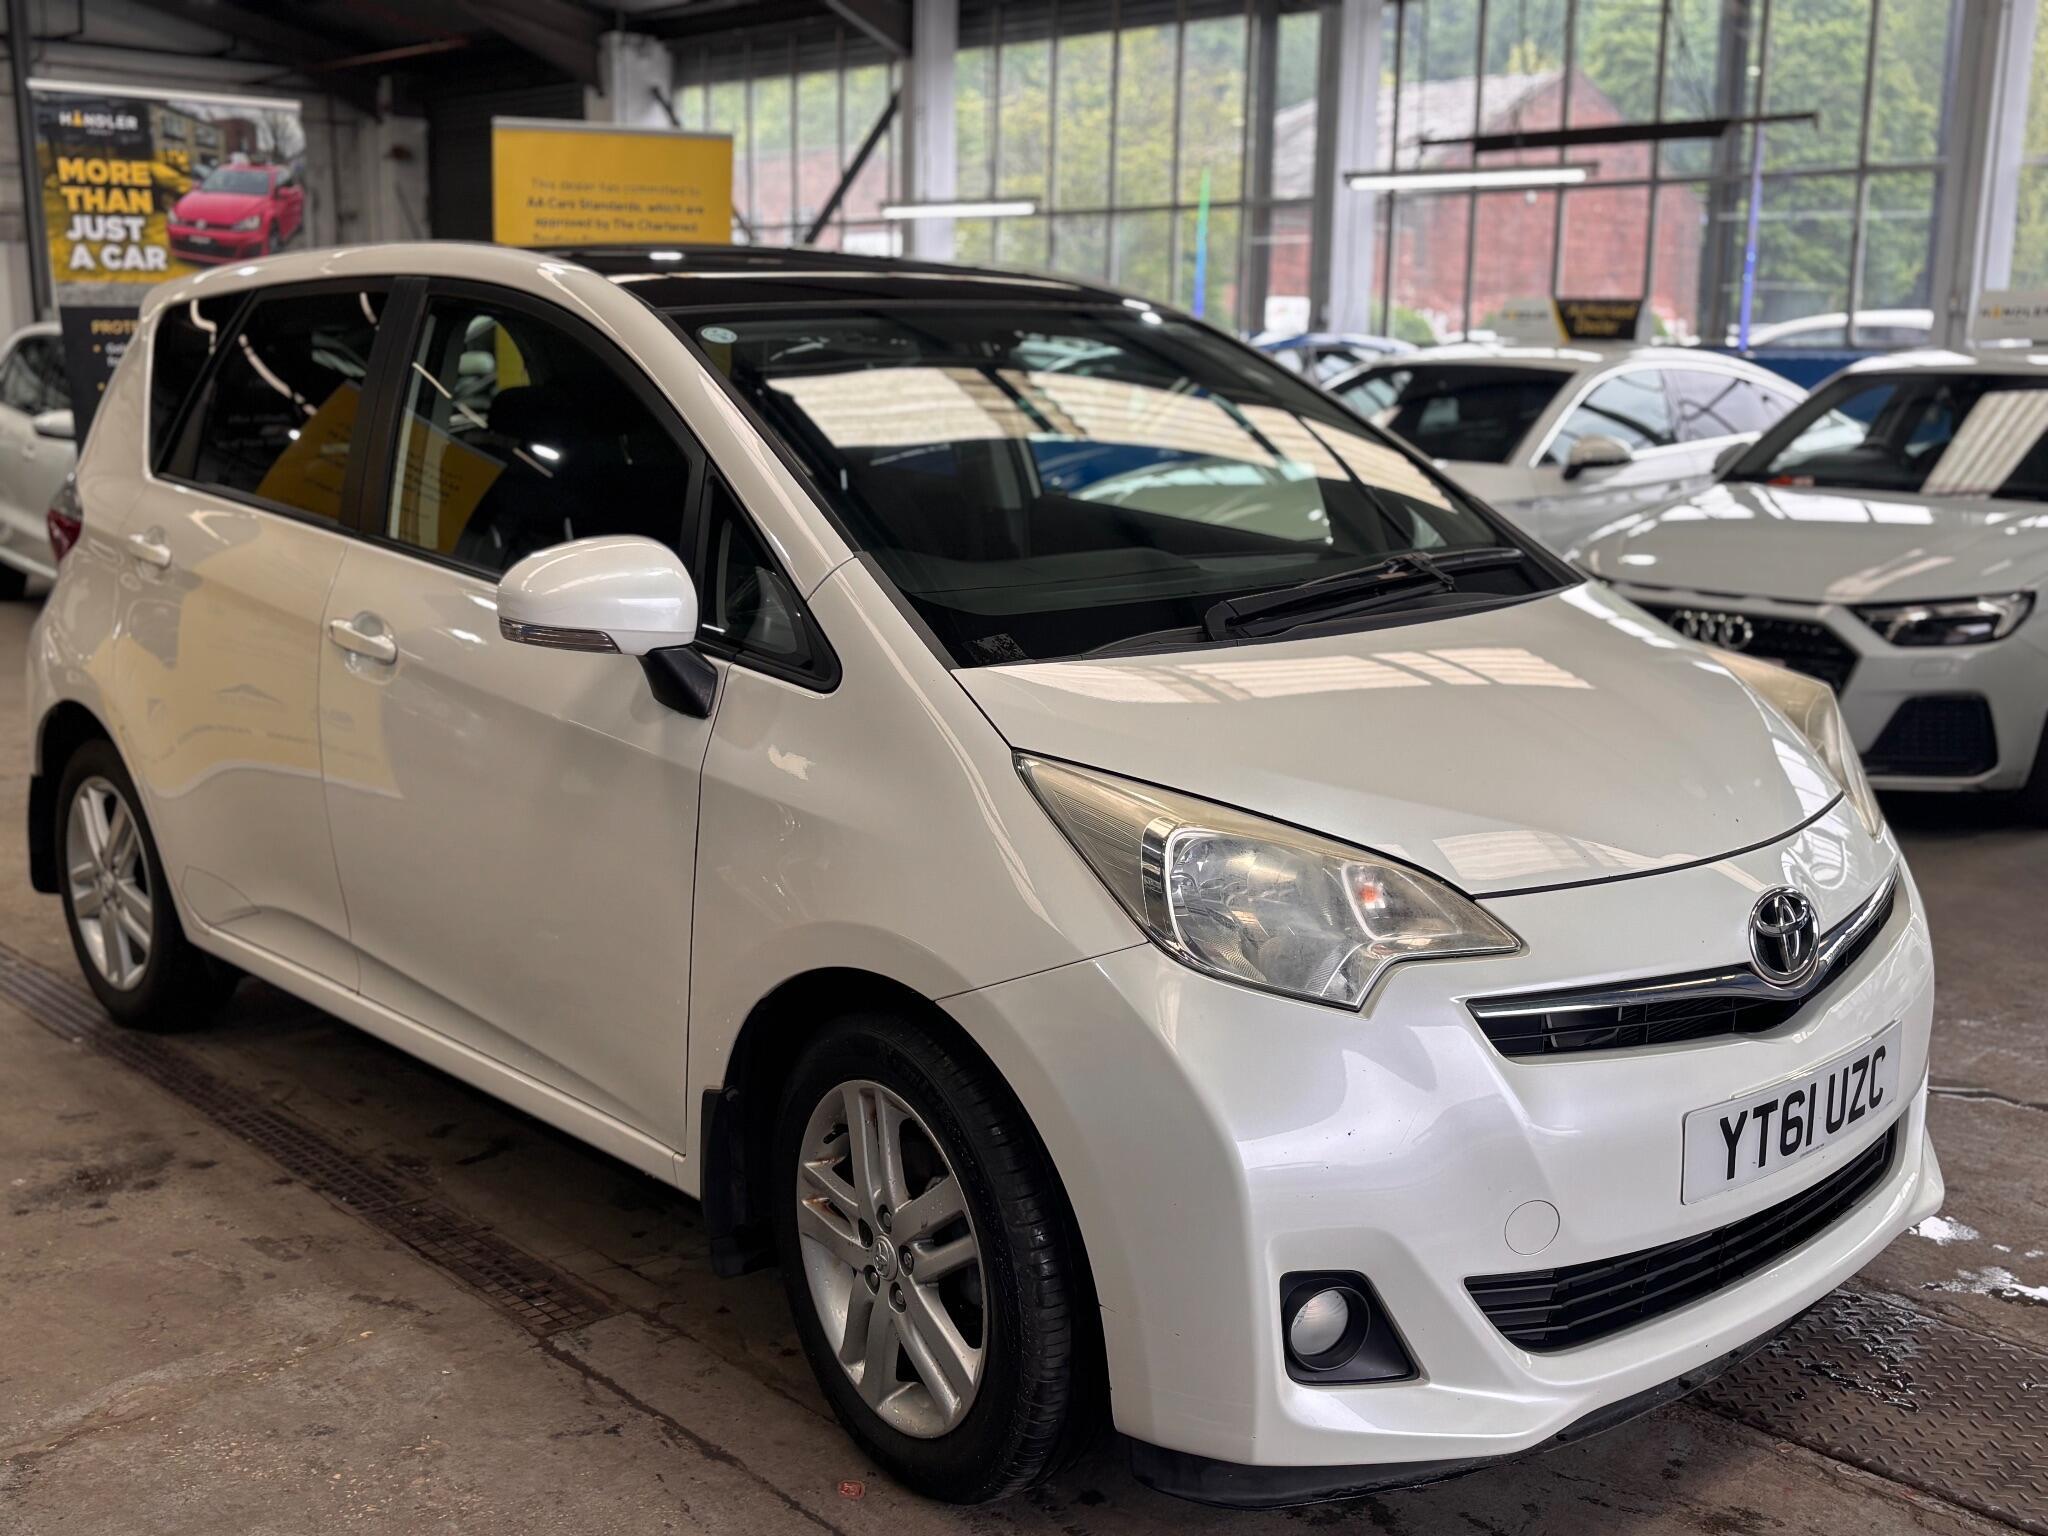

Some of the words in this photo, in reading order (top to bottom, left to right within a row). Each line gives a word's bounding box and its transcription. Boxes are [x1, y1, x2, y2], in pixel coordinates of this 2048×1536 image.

[57, 157, 152, 185] MORE
[61, 186, 153, 214] THAN
[66, 215, 146, 242] JUST
[69, 247, 95, 271] A
[102, 245, 168, 271] CAR
[1719, 1082, 1817, 1181] YT61
[1825, 1045, 1886, 1135] UZC
